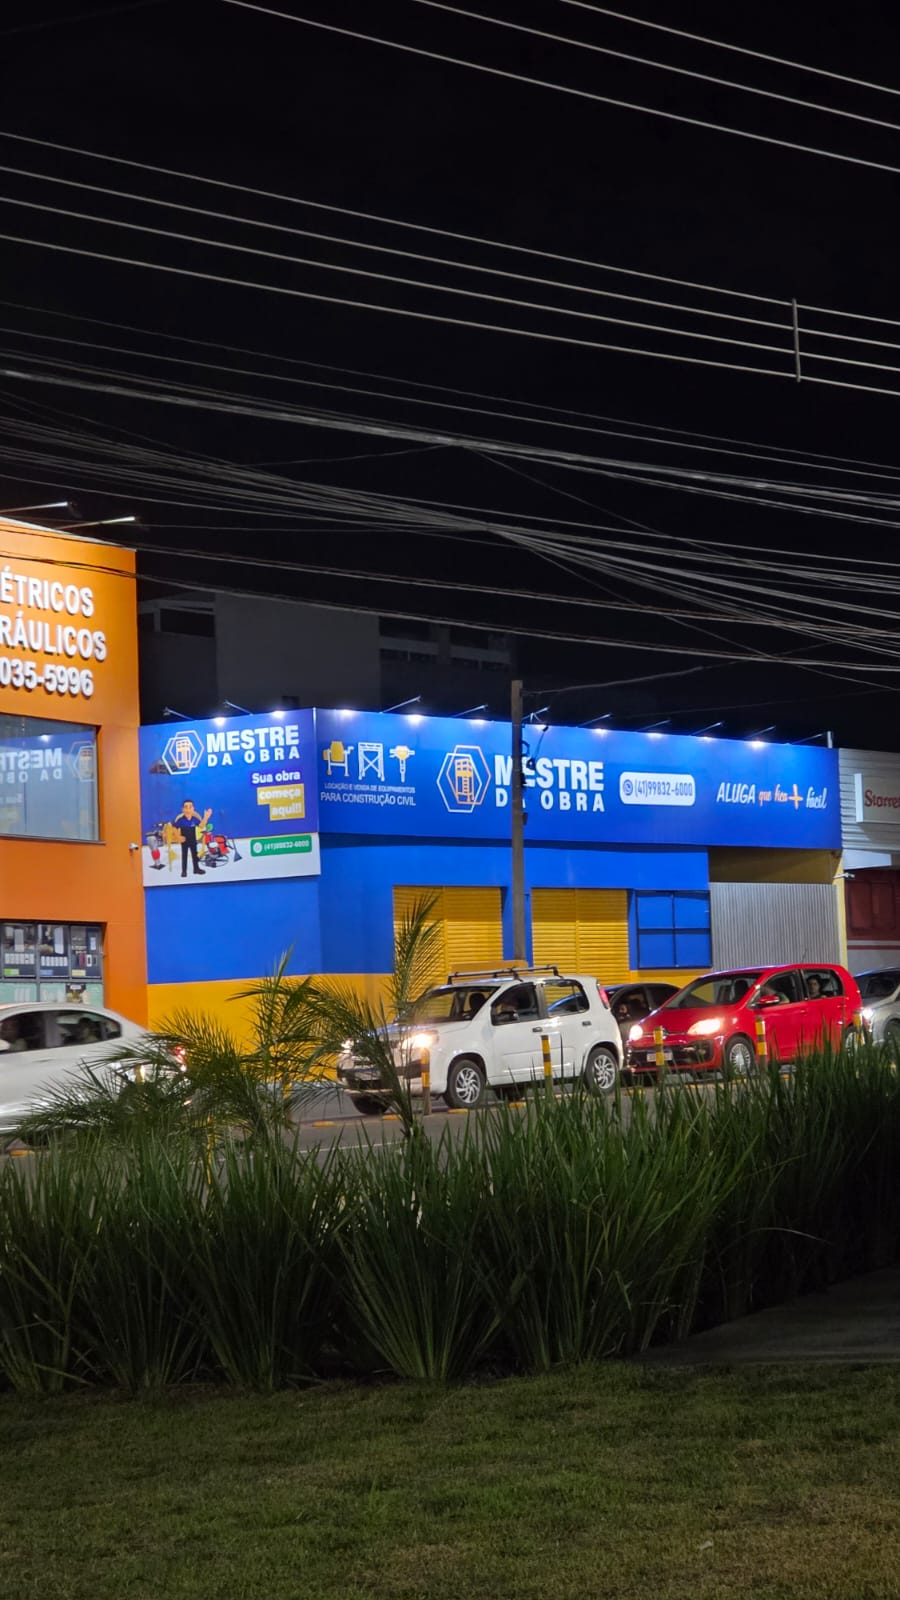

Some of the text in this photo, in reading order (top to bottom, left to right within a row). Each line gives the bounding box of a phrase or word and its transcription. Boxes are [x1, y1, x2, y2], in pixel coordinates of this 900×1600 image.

[0, 565, 94, 617] ÉTRICOS
[0, 656, 94, 697] 035-5996
[206, 725, 299, 753] MESTRE
[207, 746, 300, 767] DA OBRA
[252, 770, 301, 784] Sua obra
[633, 779, 693, 797] (41)99832-6000
[320, 791, 416, 807] PARA CONSTRUÇÃO CIVIL
[540, 790, 605, 812] OBRA
[716, 782, 756, 804] ALUGA
